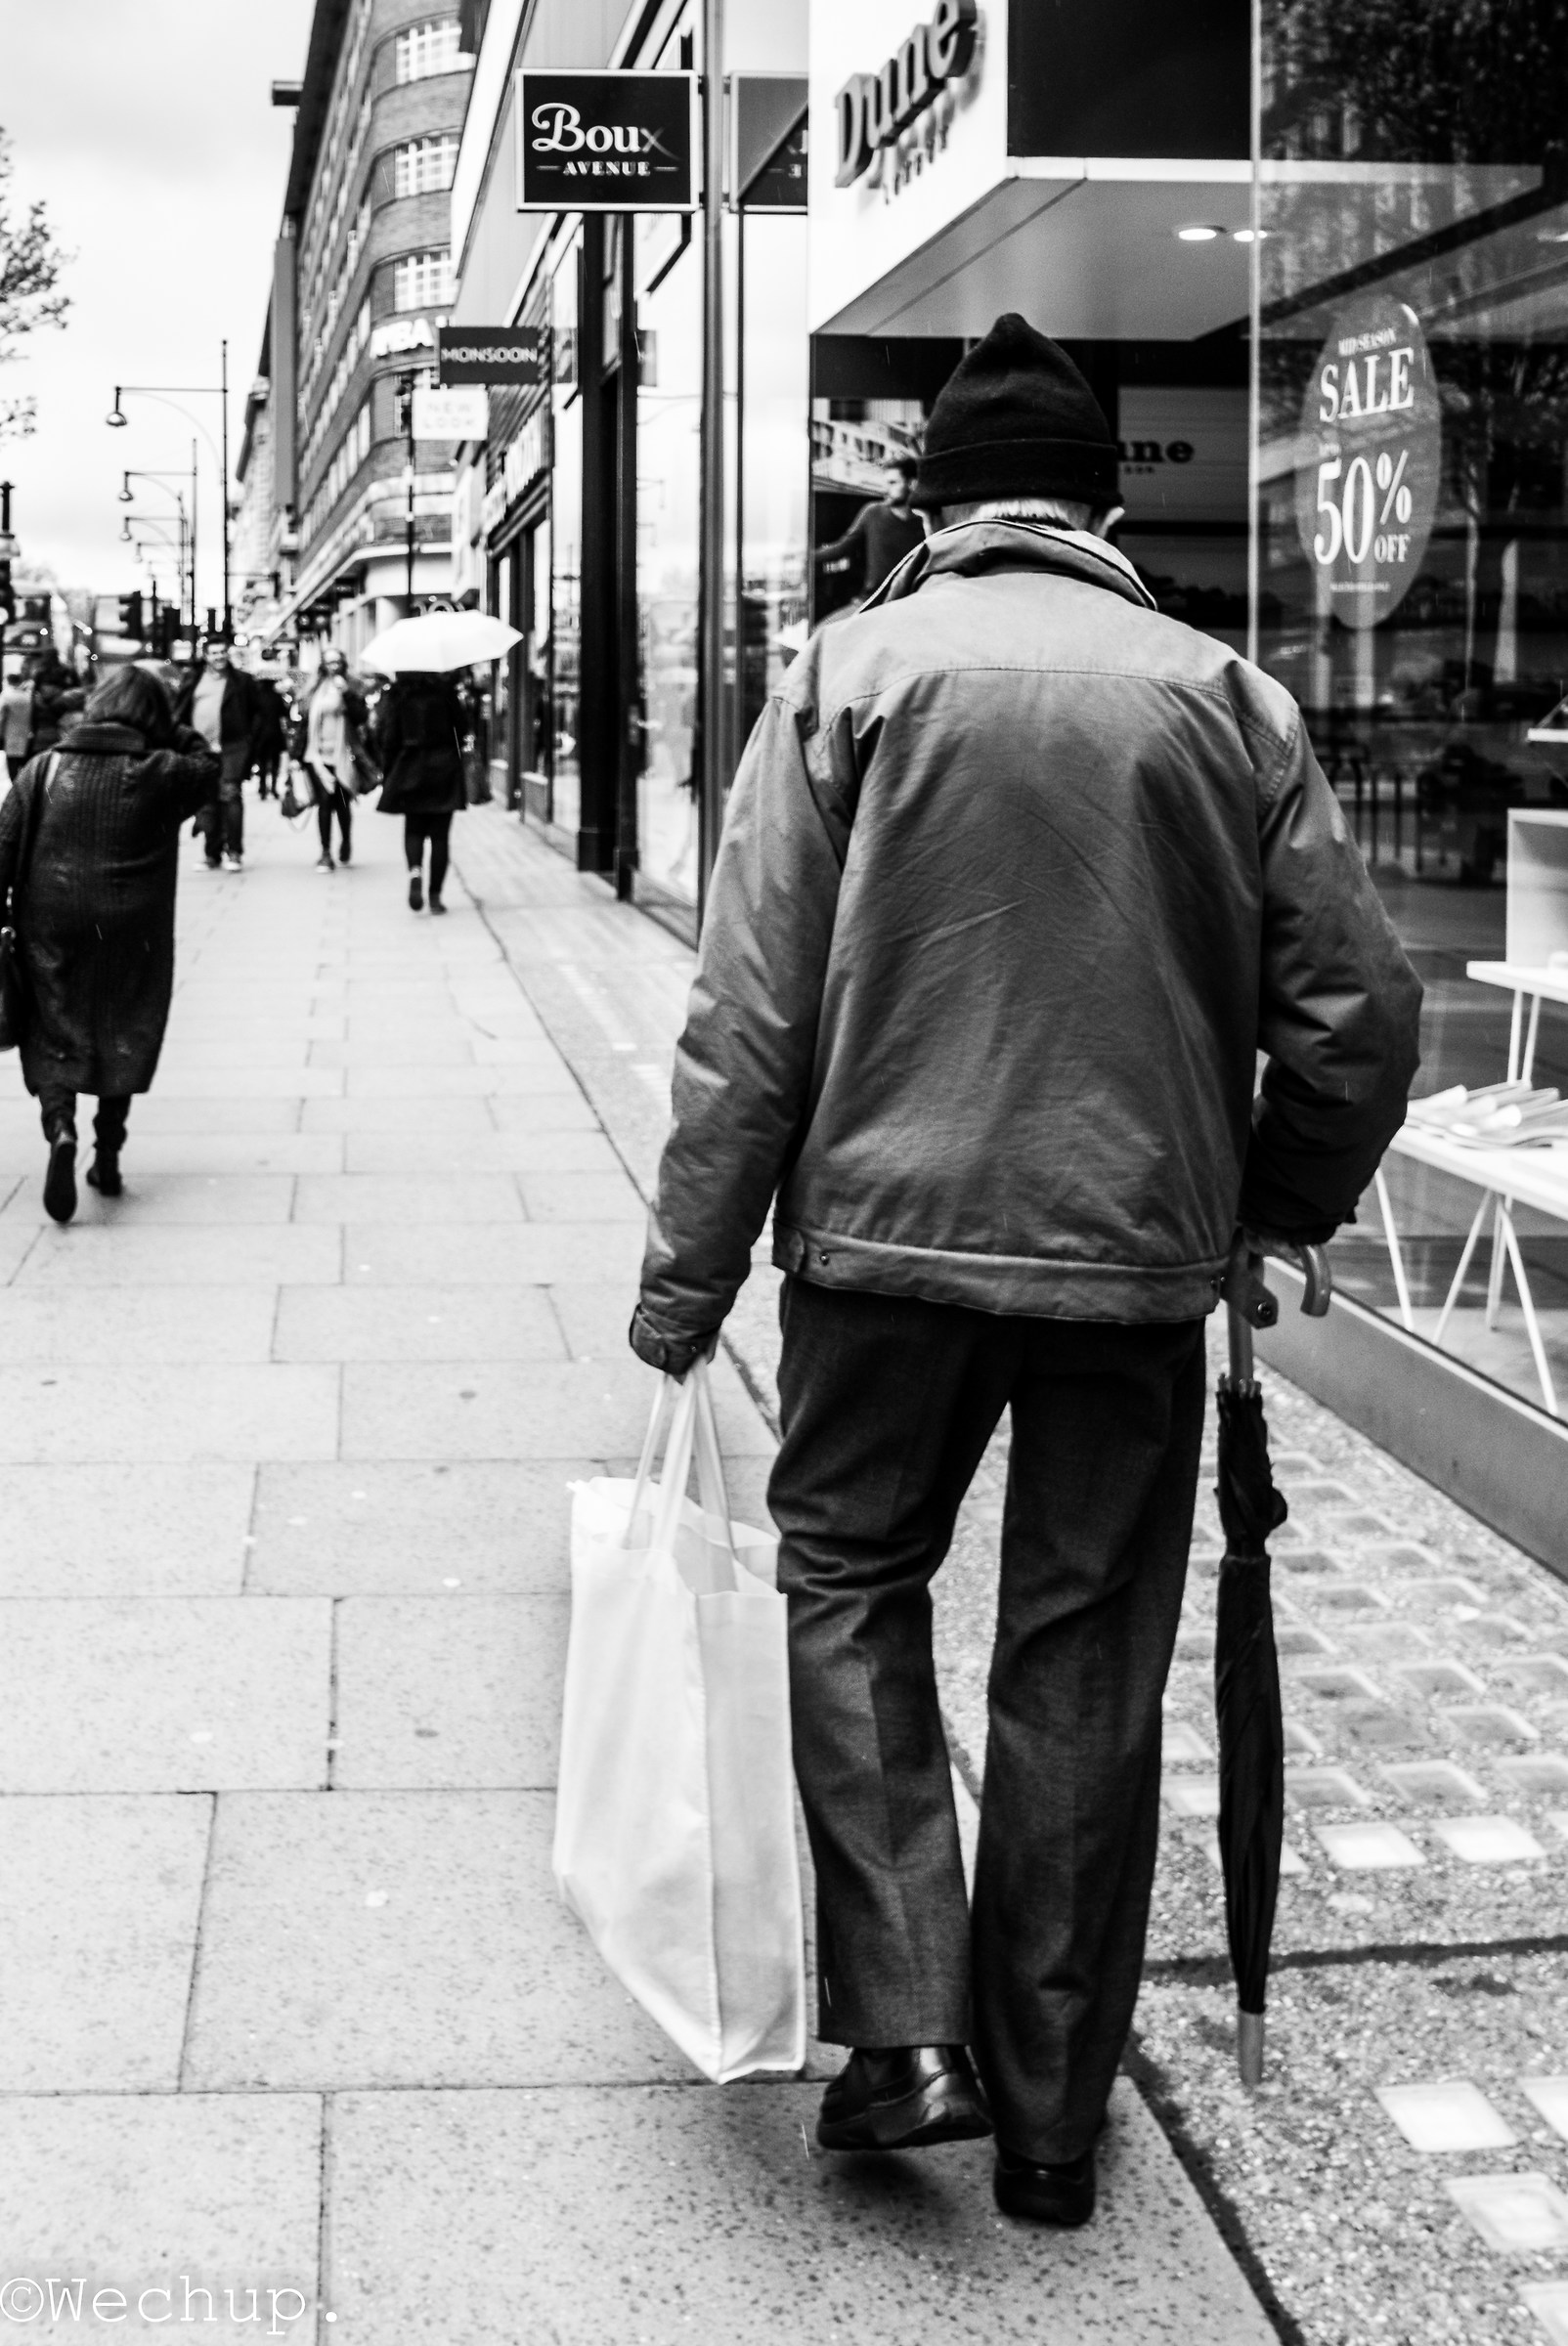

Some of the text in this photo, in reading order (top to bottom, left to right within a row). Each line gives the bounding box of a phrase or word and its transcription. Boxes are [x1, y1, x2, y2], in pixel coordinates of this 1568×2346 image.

[834, 0, 977, 188] Dune
[531, 102, 681, 160] Boux
[562, 160, 651, 177] AVENUE
[440, 346, 538, 364] MONSOON
[1320, 346, 1415, 423] SALE
[1314, 449, 1413, 565] 50%
[1374, 534, 1412, 564] OFF
